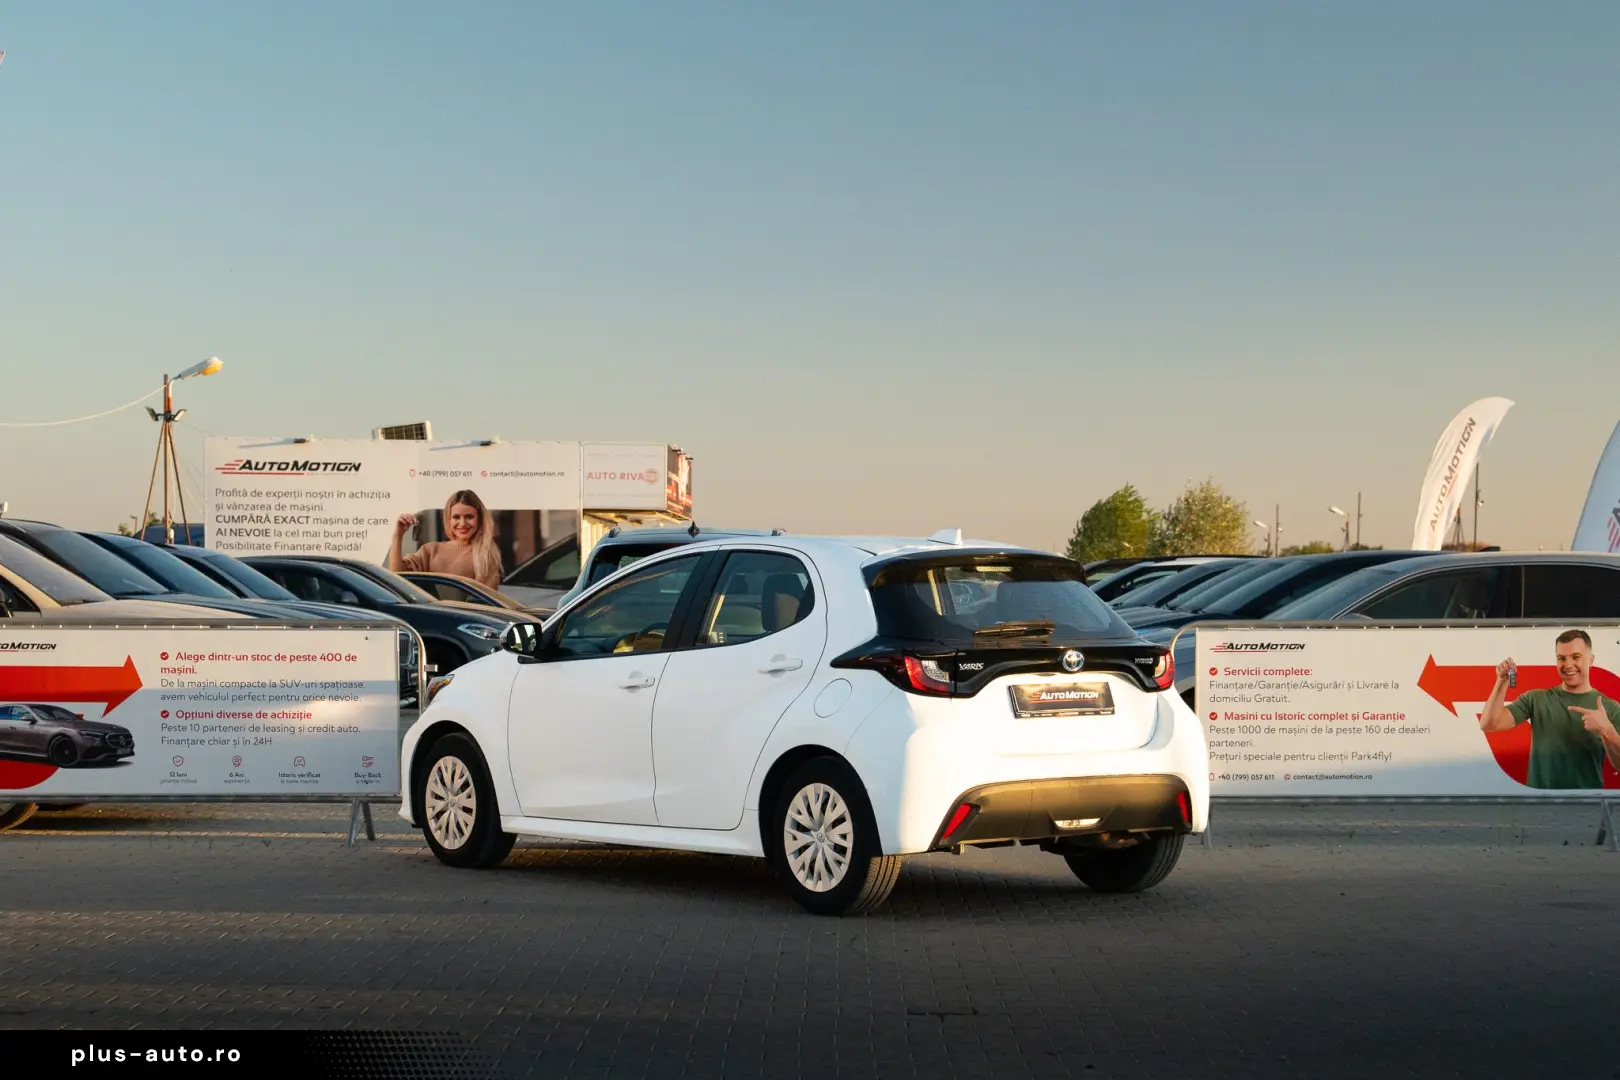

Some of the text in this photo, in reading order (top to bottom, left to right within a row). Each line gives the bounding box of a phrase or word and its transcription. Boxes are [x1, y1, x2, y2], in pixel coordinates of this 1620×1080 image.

[490, 469, 565, 478] contact@automotion.ro
[586, 472, 616, 481] AUTO
[215, 488, 248, 497] Profită
[265, 489, 302, 499] experții
[306, 490, 333, 499] noștri
[337, 490, 346, 498] în
[349, 490, 391, 499] achiziția
[215, 503, 223, 512] și
[226, 503, 272, 511] vânzarea
[274, 503, 287, 511] de
[215, 514, 271, 523] CUMPĂRĂ
[274, 516, 310, 524] EXACT
[313, 517, 349, 526] mașina
[352, 517, 365, 525] de
[215, 528, 227, 536] AI
[229, 528, 270, 537] NEVOIE
[274, 529, 282, 537] la
[302, 530, 321, 538] mai
[324, 530, 343, 538] bun
[346, 530, 367, 539] preț!
[215, 541, 361, 552] Posibilitate Finanțare Rapidă!
[175, 652, 205, 662] Alege
[208, 653, 248, 661] dintr-un
[275, 653, 287, 661] de
[290, 654, 317, 664] peste
[320, 653, 342, 661] 400
[161, 665, 197, 676] mașini.
[959, 662, 984, 671] YARIS
[1224, 667, 1313, 677] Servicii complete:
[161, 679, 174, 687] De
[177, 679, 185, 688] la
[188, 679, 217, 690] mașini
[219, 681, 266, 690] compacte
[269, 680, 277, 688] la
[280, 680, 317, 689] SUV-uri
[1348, 681, 1354, 691] și
[1357, 681, 1389, 689] Livrare
[1391, 681, 1399, 689] la
[188, 692, 229, 701] vehiculul
[232, 692, 266, 703] perfect
[269, 694, 300, 703] pentru
[303, 693, 325, 701] orice
[329, 693, 361, 702] nevoie.
[1209, 694, 1290, 702] domiciliu Gratuit.
[176, 710, 312, 720] Opțiuni diverse de achiziție
[1275, 712, 1305, 720] Istoric
[1308, 712, 1349, 722] complet
[1351, 712, 1360, 722] și
[1362, 712, 1405, 722] Garanție
[161, 723, 187, 732] Peste
[190, 724, 200, 732] 10
[202, 724, 246, 734] parteneri
[248, 724, 260, 732] de
[263, 724, 295, 735] leasing
[298, 725, 305, 735] și
[308, 725, 335, 733] credit
[1209, 725, 1235, 734] Peste
[1238, 725, 1261, 734] 1000
[1264, 726, 1276, 734] de
[1279, 725, 1308, 736] mașini
[1325, 725, 1333, 734] la
[1336, 727, 1362, 736] peste
[1365, 725, 1381, 734] 160
[1383, 726, 1395, 734] de
[1398, 725, 1430, 733] dealeri
[161, 737, 272, 748] Finanțare chiar și în 24H
[1209, 739, 1254, 749] parteneri.
[1209, 751, 1392, 763] Prețuri speciale pentru clienții Park4fly!
[1232, 772, 1249, 780] (799)
[1251, 772, 1262, 780] 057
[1264, 772, 1274, 780] 611
[1293, 772, 1372, 780] contact@automotion.ro
